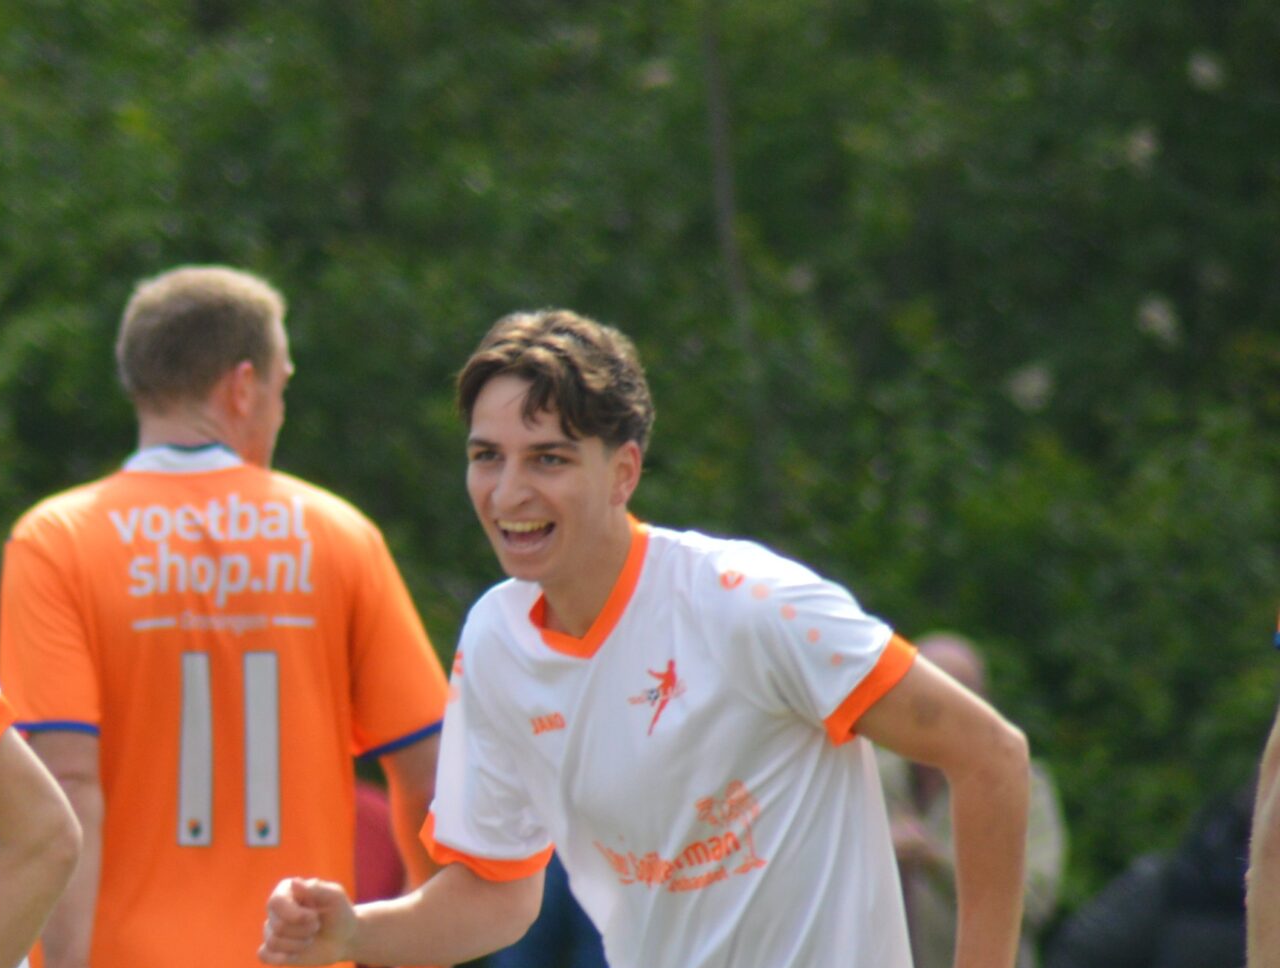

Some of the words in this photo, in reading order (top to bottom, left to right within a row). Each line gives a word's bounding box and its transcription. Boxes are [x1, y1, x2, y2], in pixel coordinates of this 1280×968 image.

[109, 493, 308, 544] voetbal
[128, 539, 314, 607] shop.nl
[176, 651, 281, 847] 11
